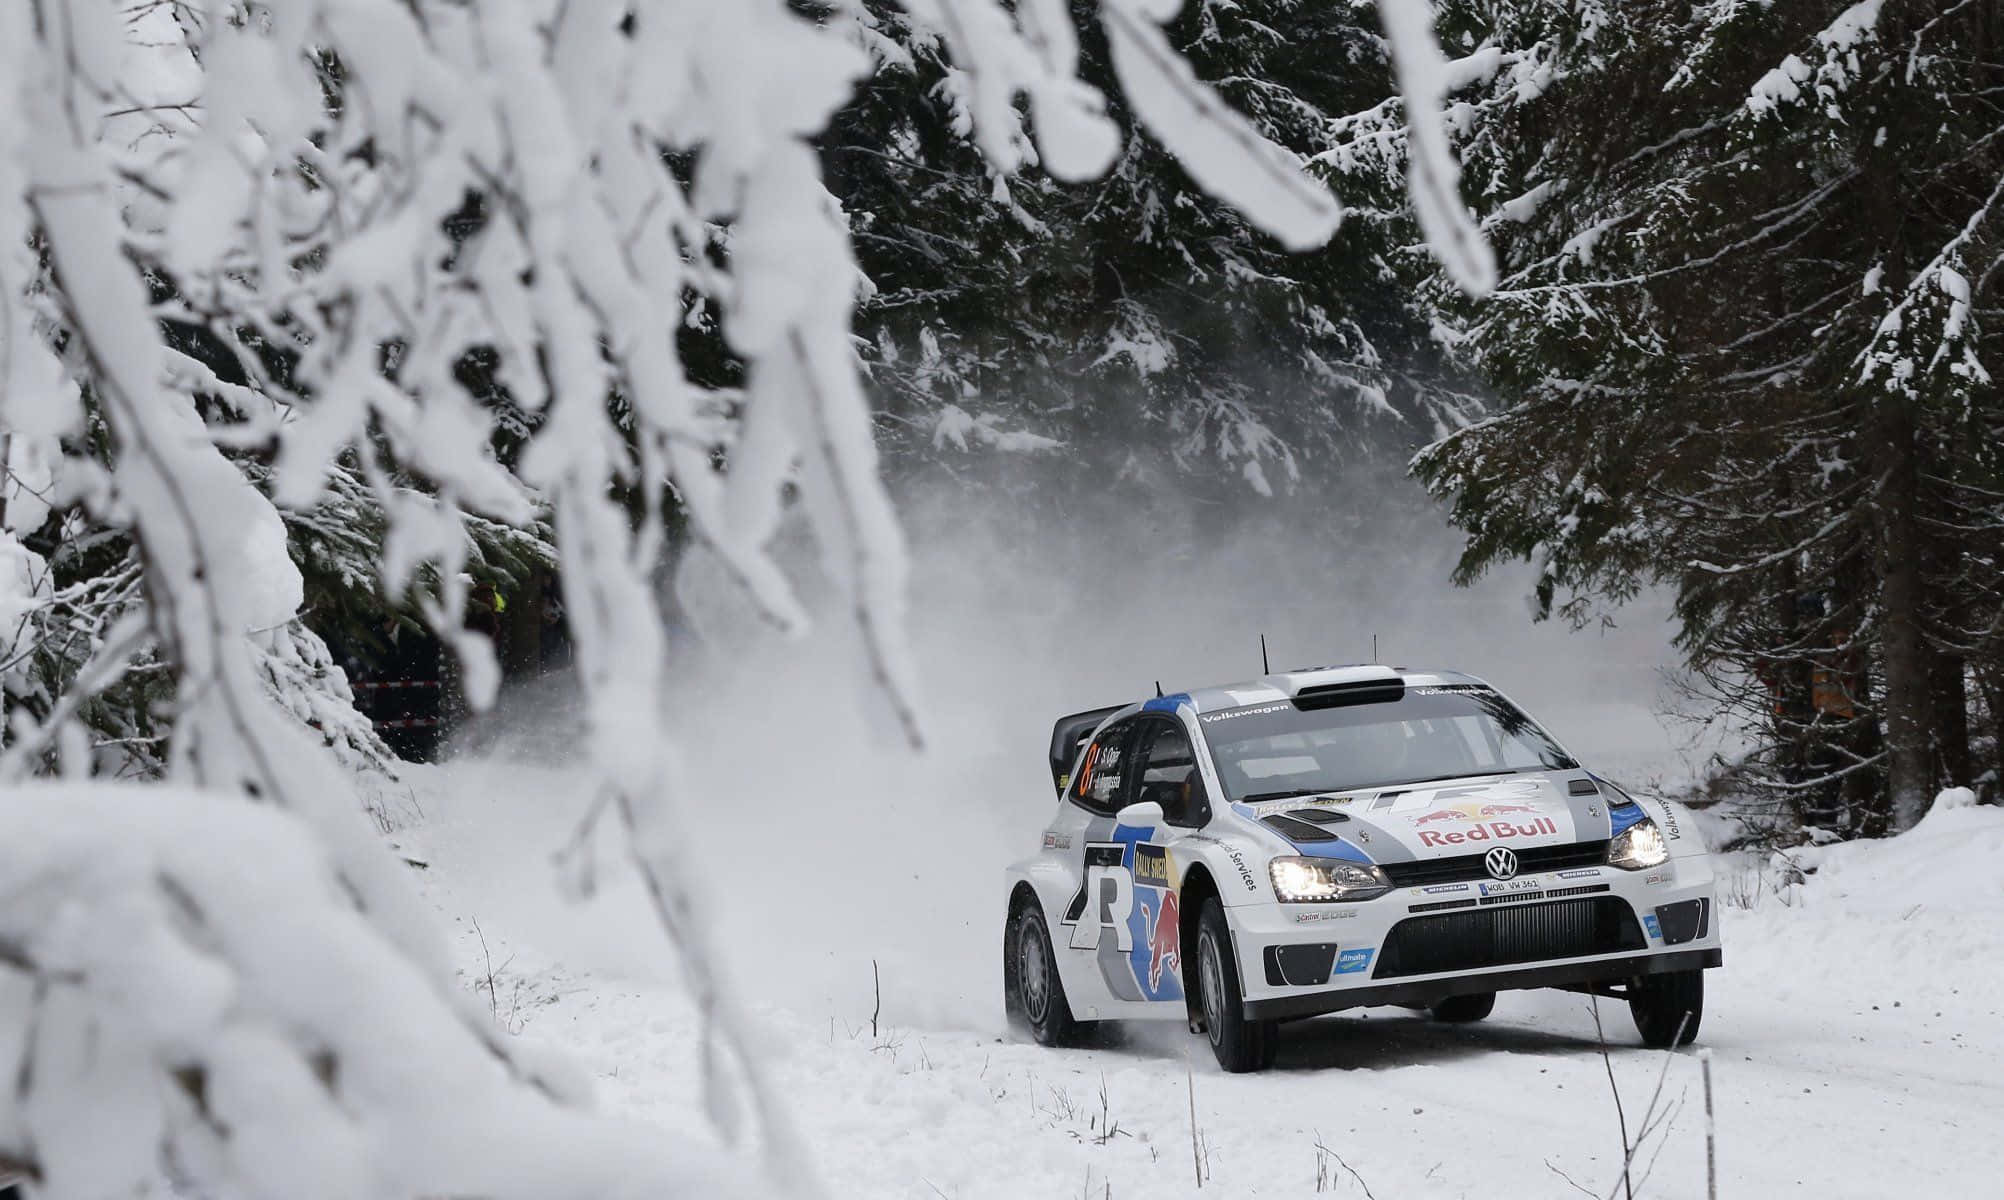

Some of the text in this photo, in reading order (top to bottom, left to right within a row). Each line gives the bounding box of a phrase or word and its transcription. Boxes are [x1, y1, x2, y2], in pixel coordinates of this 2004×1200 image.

[1203, 705, 1289, 722] Volkswagen
[1079, 743, 1099, 796] 8
[1418, 817, 1557, 847] Red Bull
[1135, 850, 1151, 877] RALLY
[1230, 852, 1257, 892] Services
[1562, 868, 1601, 878] MICHELIN
[1428, 883, 1468, 893] MICHELIN
[1521, 880, 1539, 889] 361
